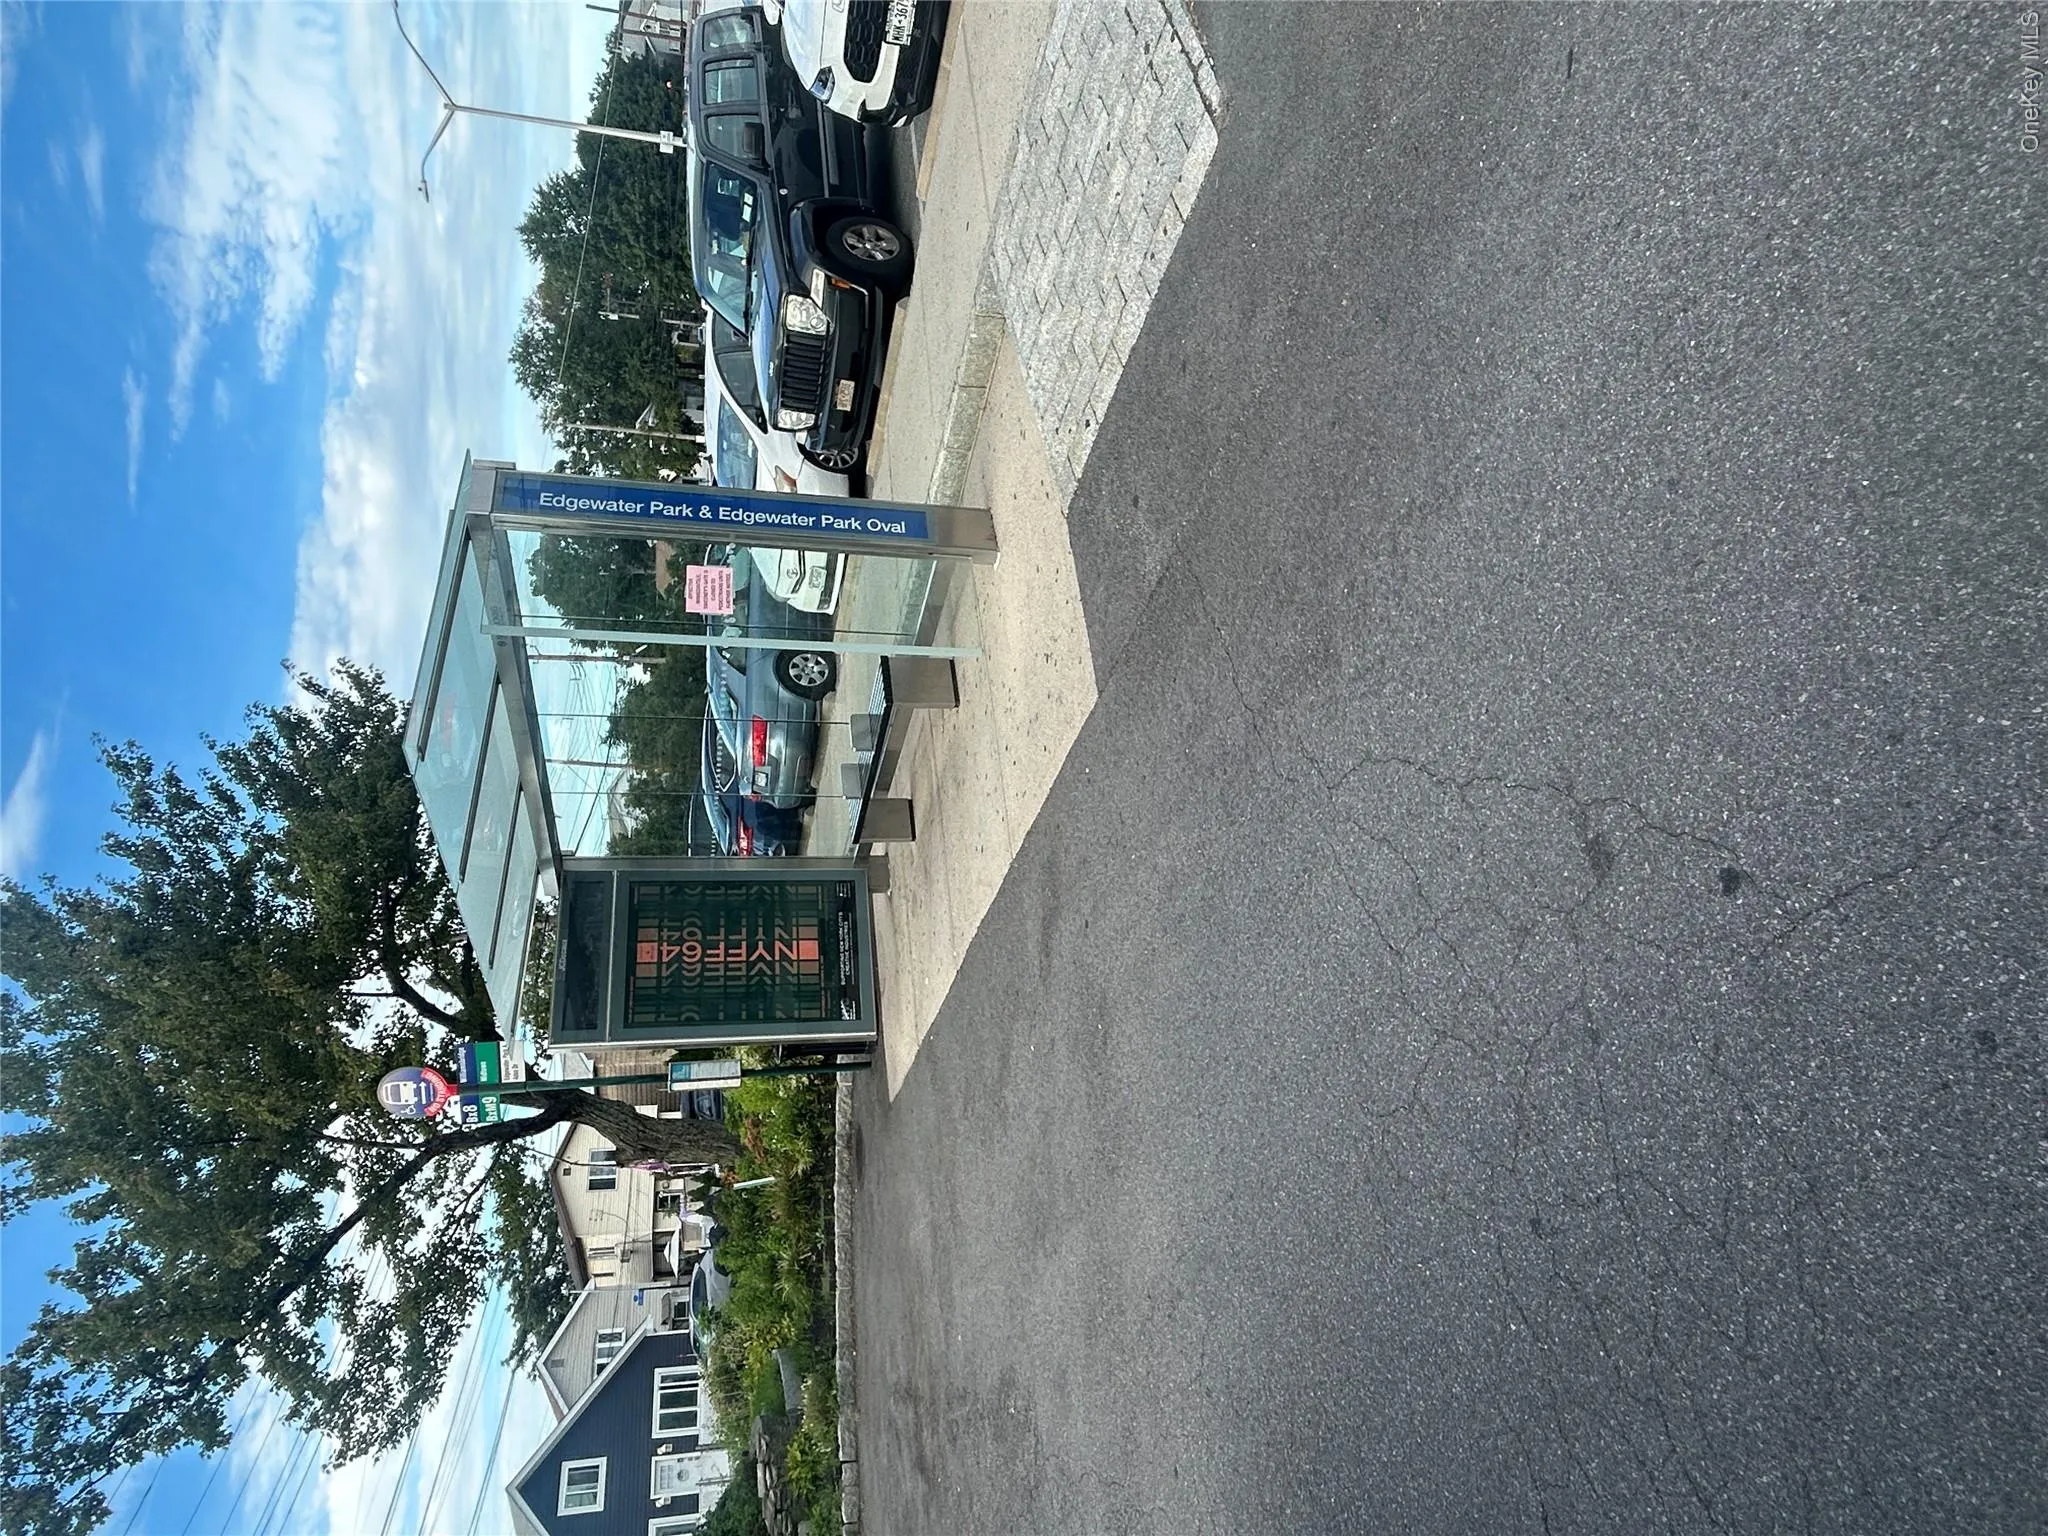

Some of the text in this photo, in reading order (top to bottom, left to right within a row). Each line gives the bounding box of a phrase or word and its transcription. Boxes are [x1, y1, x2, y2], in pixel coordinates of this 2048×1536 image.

[539, 492, 906, 534] Edgewater Park & Edgewater Park Oval
[659, 940, 798, 963] NYFF64
[463, 1105, 479, 1122] Bx8
[481, 1096, 499, 1122] BxM9
